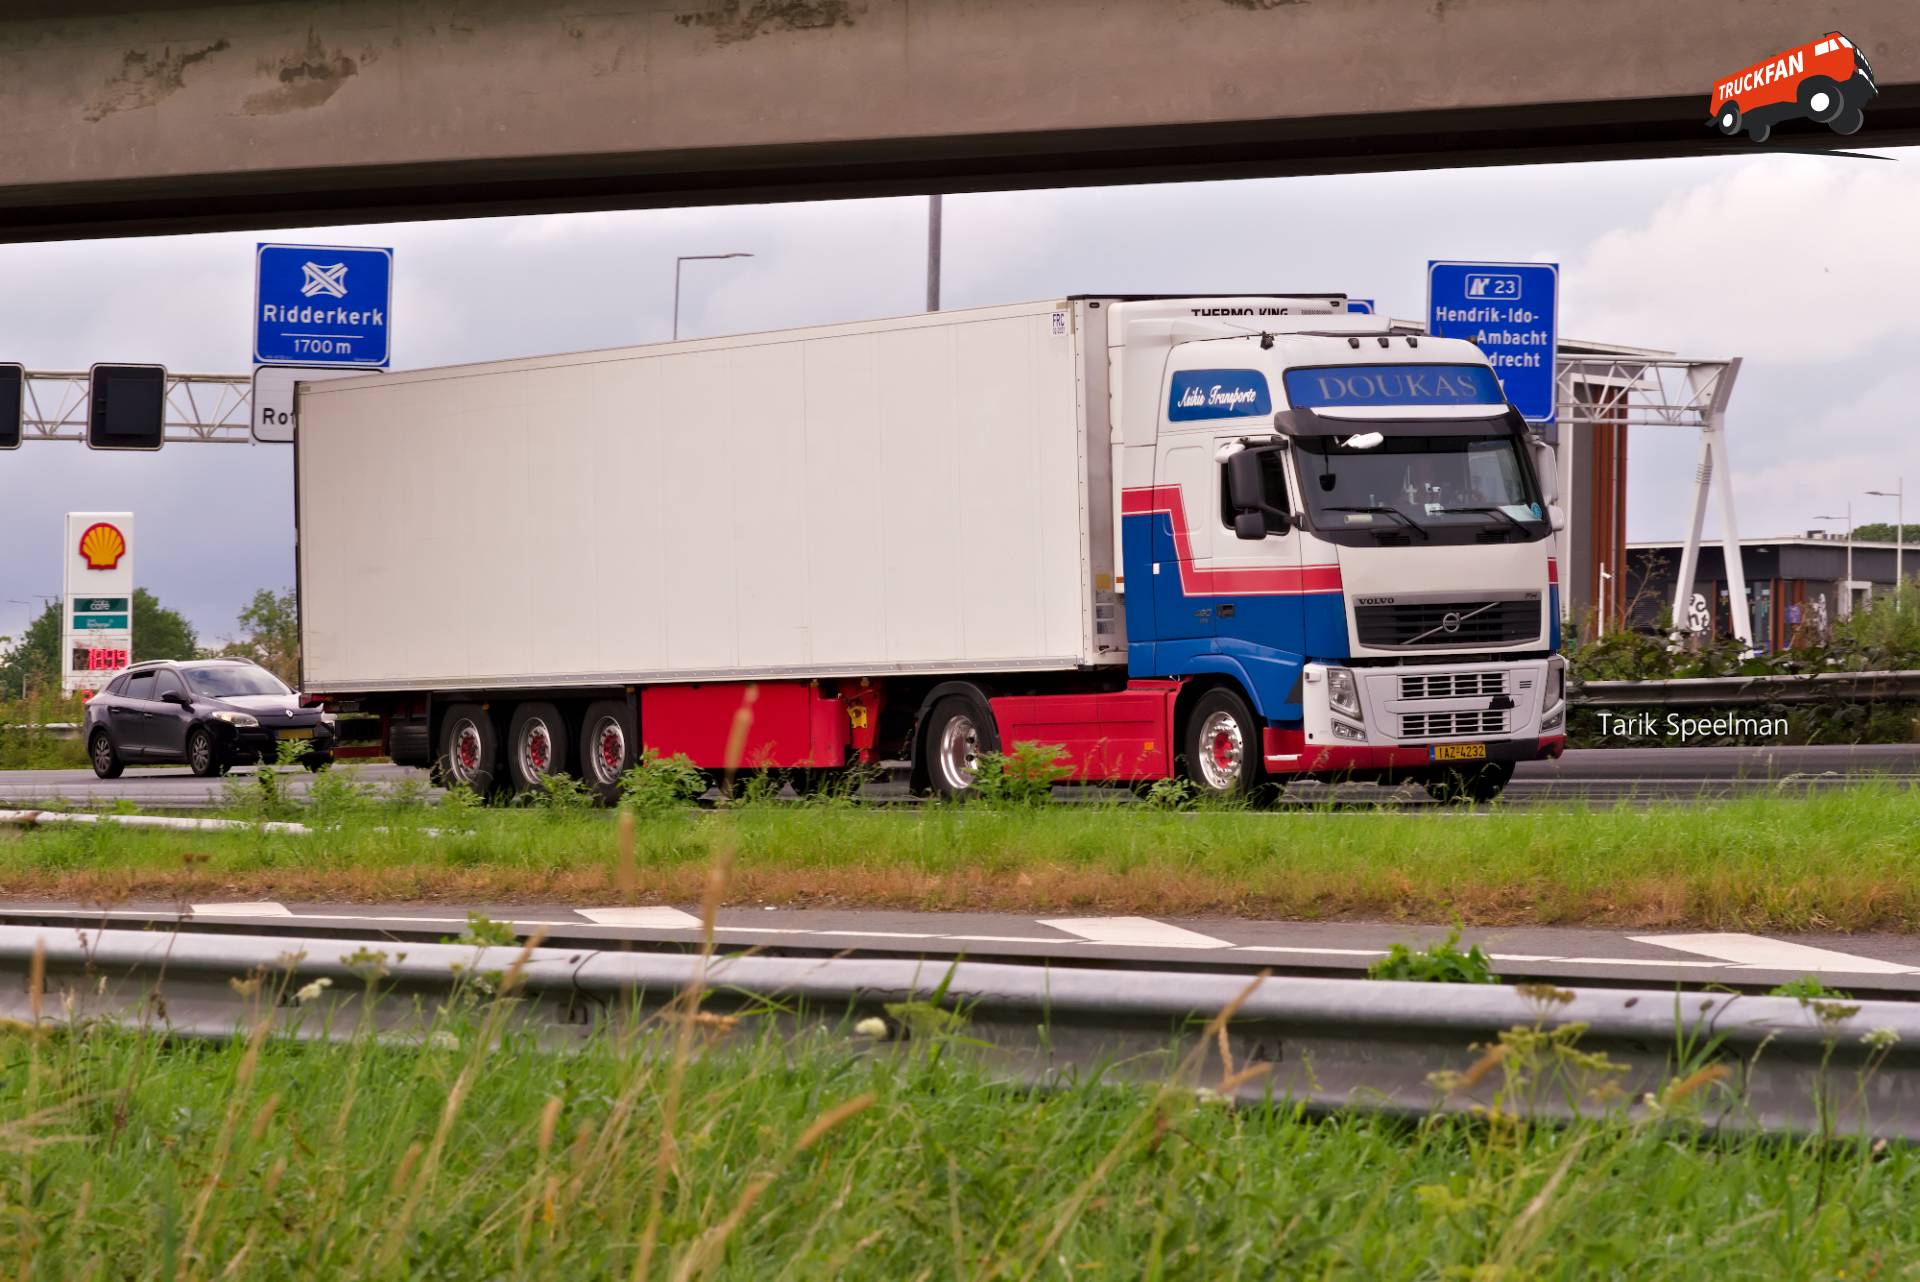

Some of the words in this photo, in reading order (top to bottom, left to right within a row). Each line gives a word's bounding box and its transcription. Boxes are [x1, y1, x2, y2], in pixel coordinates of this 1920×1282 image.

[1494, 280, 1516, 294] 23
[263, 304, 384, 326] Ridderkerk
[1052, 313, 1065, 327] FRC
[1436, 306, 1539, 323] Hendrik-Ido-
[1477, 329, 1547, 345] Ambacht
[294, 339, 333, 354] 1700
[336, 342, 351, 354] m
[1316, 374, 1477, 400] DOUKAS
[1358, 597, 1395, 605] VOLVO
